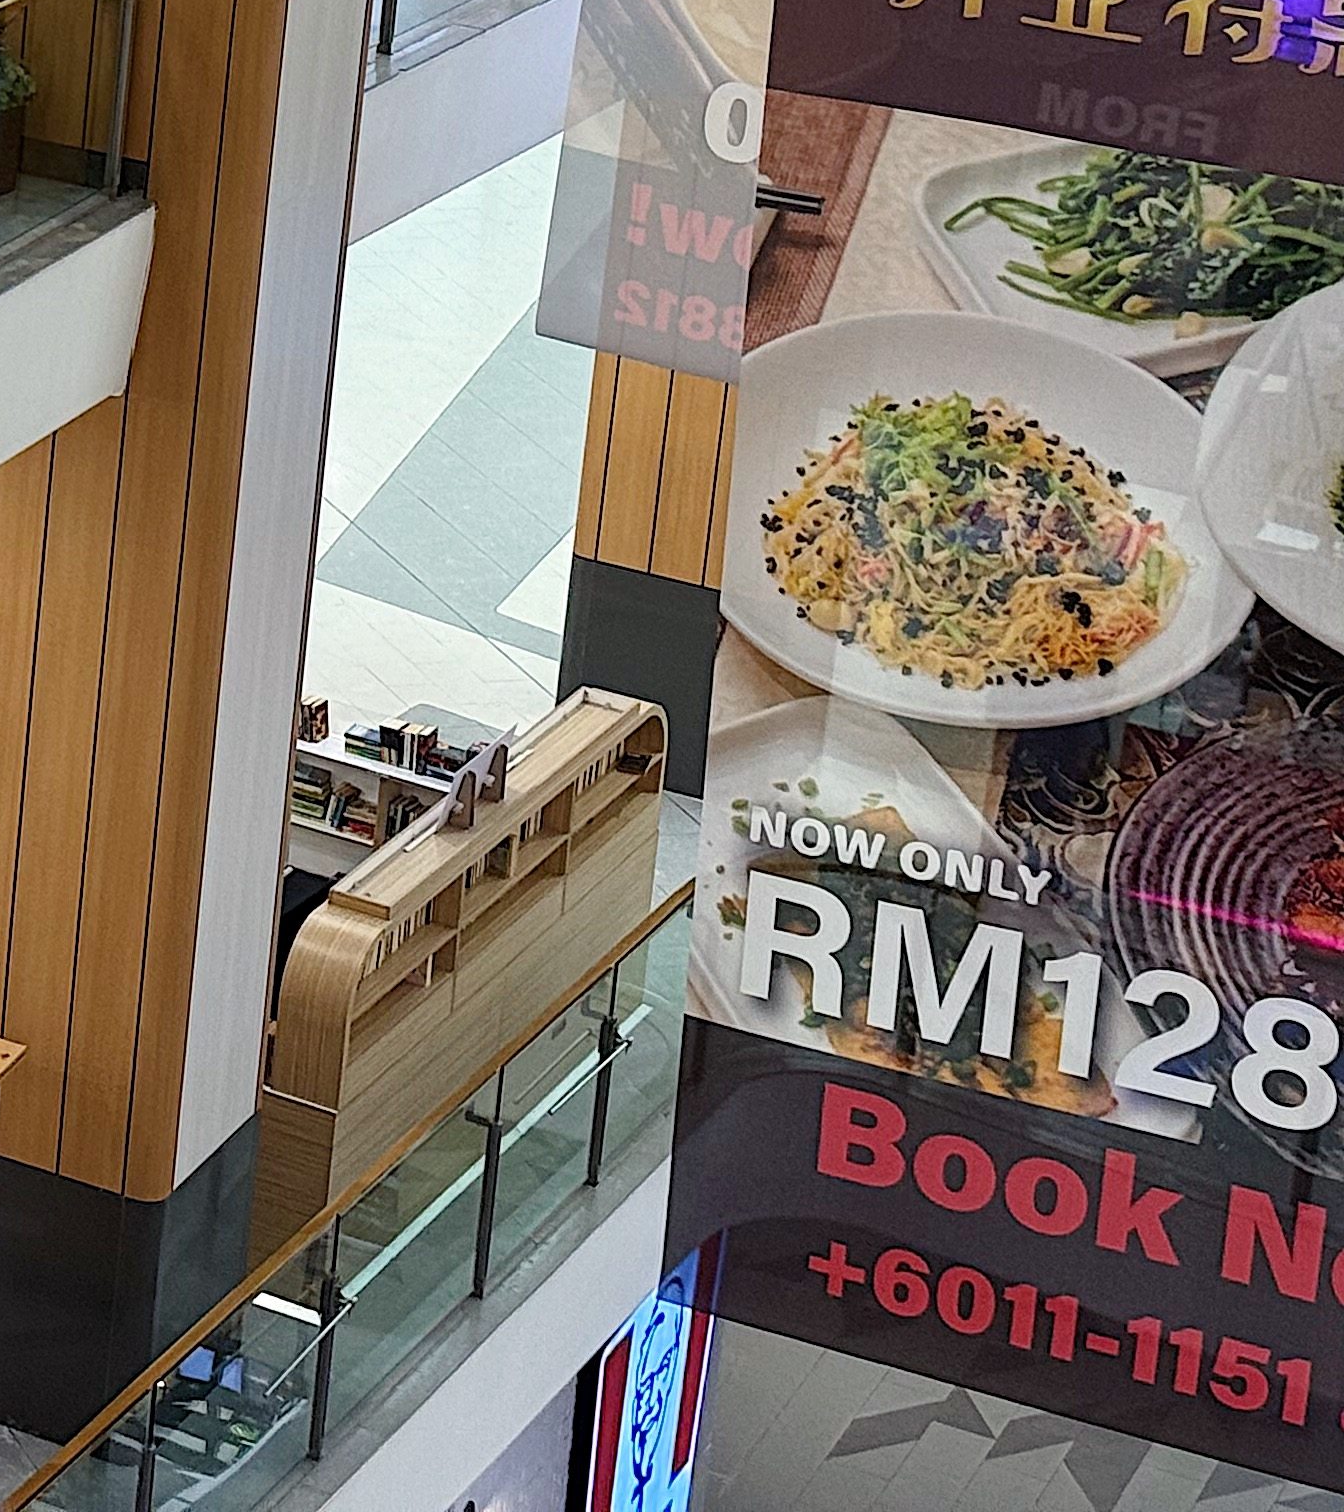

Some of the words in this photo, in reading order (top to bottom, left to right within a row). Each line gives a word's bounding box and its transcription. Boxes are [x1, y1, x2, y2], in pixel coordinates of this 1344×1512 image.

[748, 806, 886, 869] NOW
[898, 840, 1053, 905] ONLY
[739, 869, 1341, 1132] RM128
[816, 1082, 1183, 1266] Book
[1220, 1184, 1344, 1304] N
[808, 1240, 1312, 1427] +6011-1151
